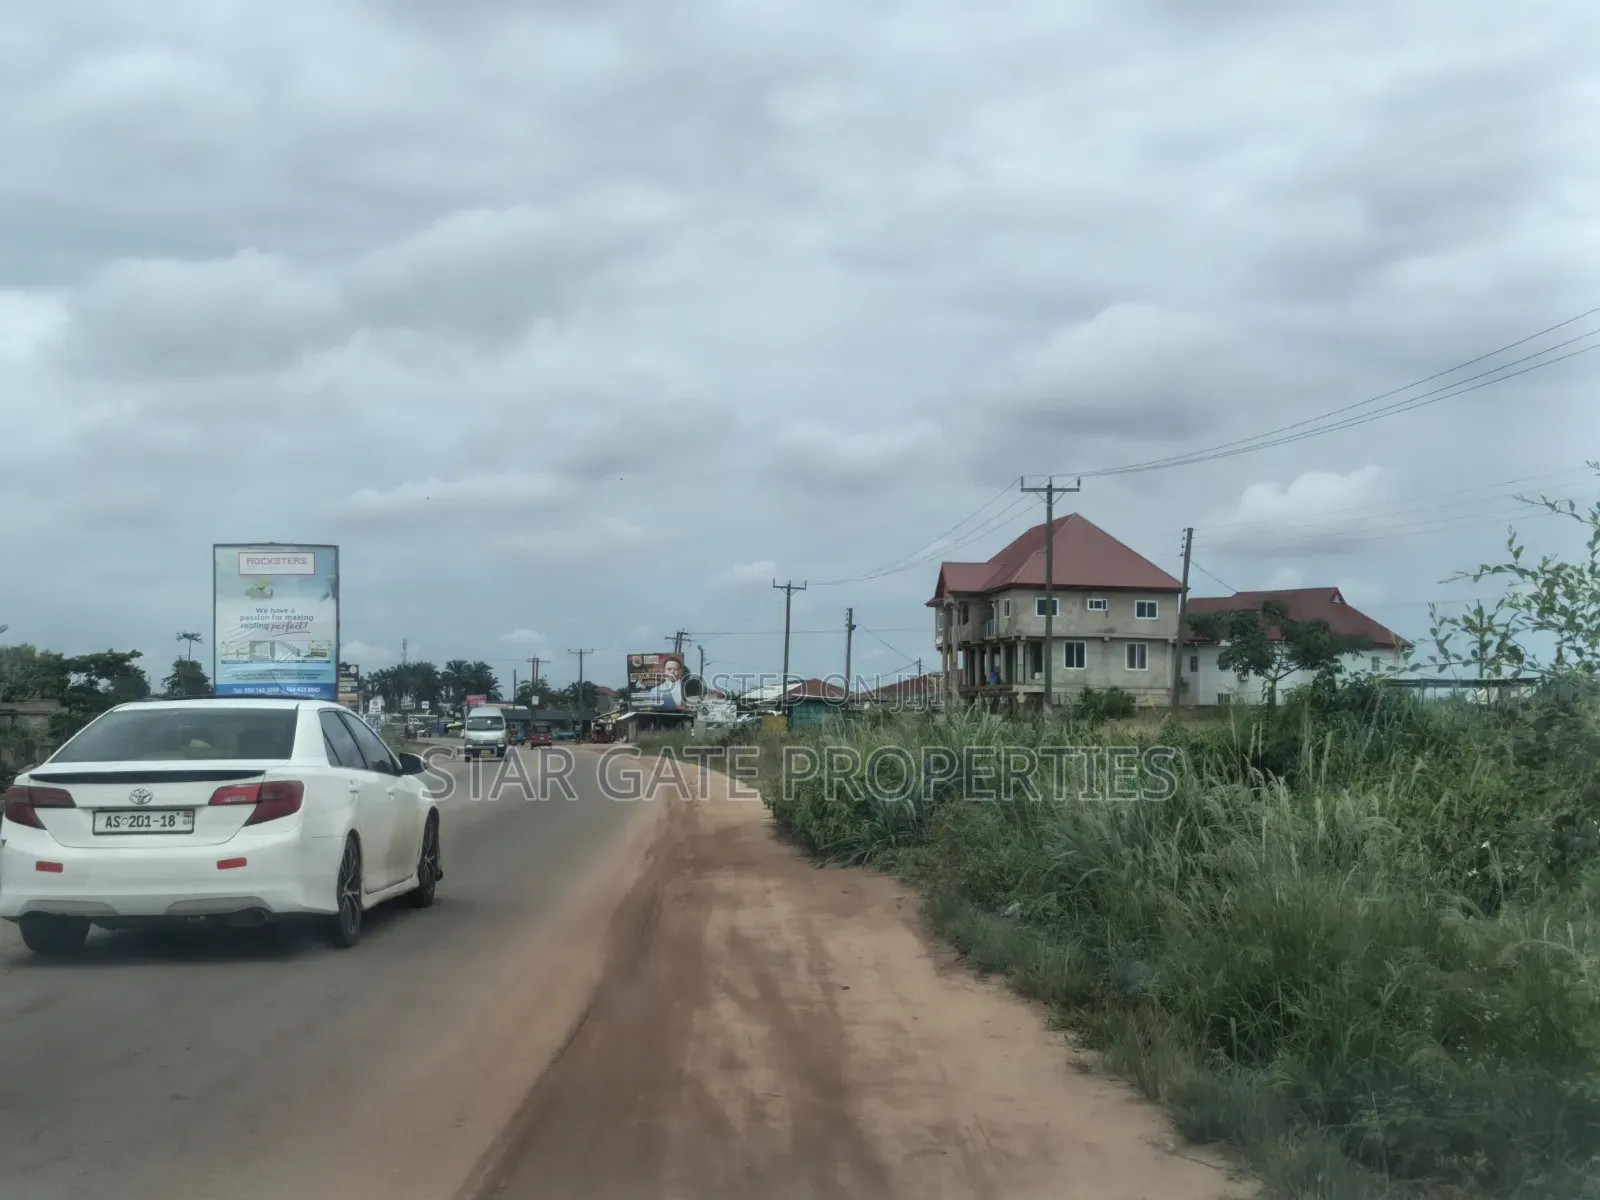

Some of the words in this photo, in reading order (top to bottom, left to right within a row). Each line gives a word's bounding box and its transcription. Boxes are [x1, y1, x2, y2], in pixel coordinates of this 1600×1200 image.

[246, 557, 307, 565] ROCKSTERS
[240, 614, 269, 622] passion
[285, 614, 314, 622] making
[240, 622, 269, 630] roofing
[270, 621, 308, 632] perfect!
